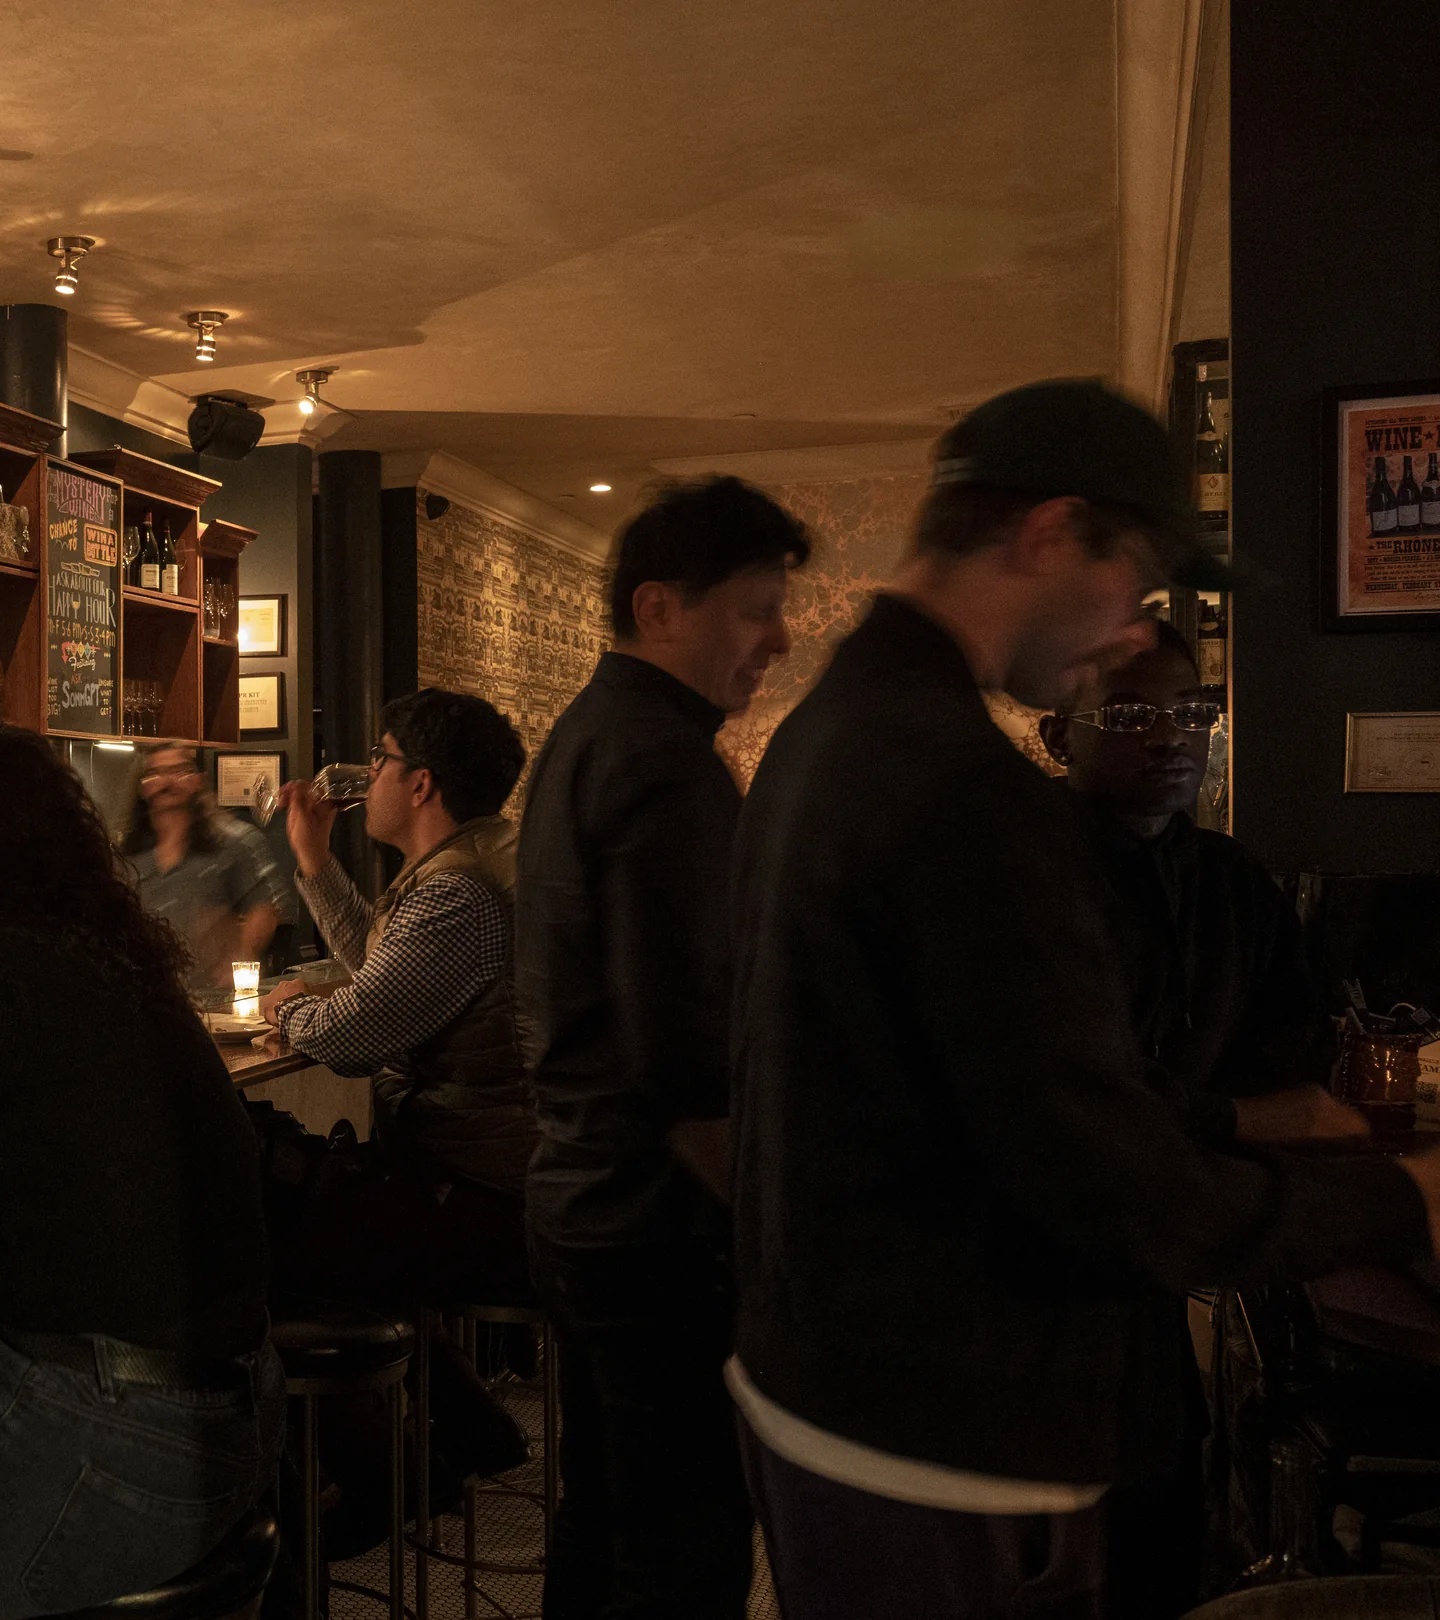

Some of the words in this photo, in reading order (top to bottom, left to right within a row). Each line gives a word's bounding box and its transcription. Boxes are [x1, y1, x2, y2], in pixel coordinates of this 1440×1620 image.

[1364, 426, 1422, 452] WINE
[56, 469, 105, 523] MYSTERY
[68, 499, 95, 522] WINE
[49, 519, 78, 540] CHANCE
[86, 527, 107, 545] WIN
[68, 537, 78, 551] TO
[86, 541, 116, 562] BOTTLE
[1376, 540, 1393, 550] THE
[48, 574, 81, 619] HAPPY
[85, 587, 117, 628] HOUR
